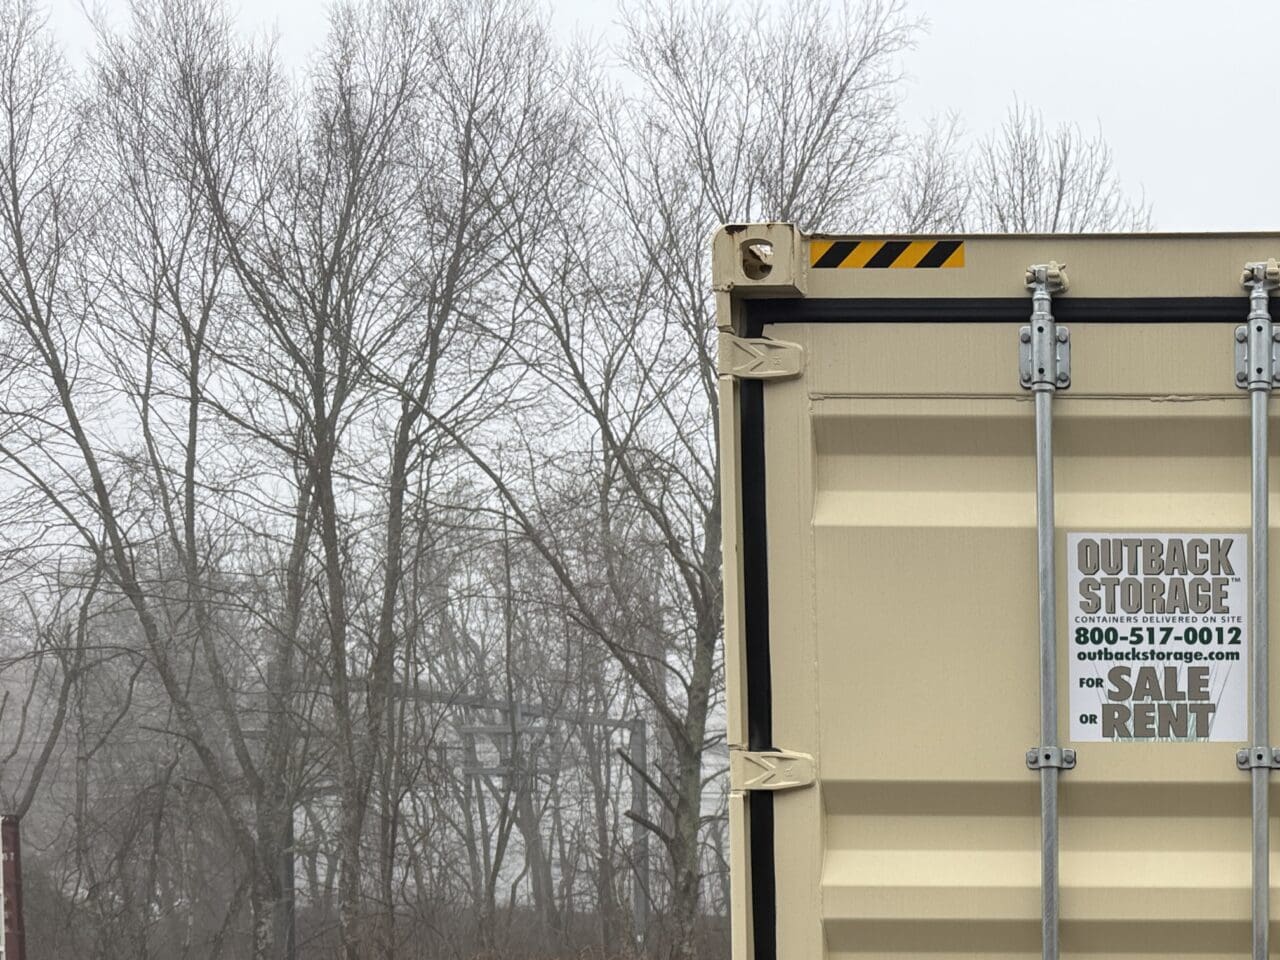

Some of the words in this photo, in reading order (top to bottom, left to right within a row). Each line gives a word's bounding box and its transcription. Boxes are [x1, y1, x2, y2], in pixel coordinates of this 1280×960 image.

[1077, 538, 1235, 576] OUTBACK
[1078, 577, 1230, 615] STORAGE
[1074, 616, 1139, 624] CONTAINERS
[1142, 616, 1198, 624] DELIVERED
[1202, 616, 1217, 624] ON
[1221, 616, 1243, 624] SITE
[1074, 626, 1242, 646] 800-517-0012
[1076, 647, 1240, 664] outbackstorage.com
[1079, 677, 1104, 689] FOR
[1107, 665, 1211, 702] SALE
[1079, 714, 1098, 725] OR
[1101, 703, 1217, 739] RENT
